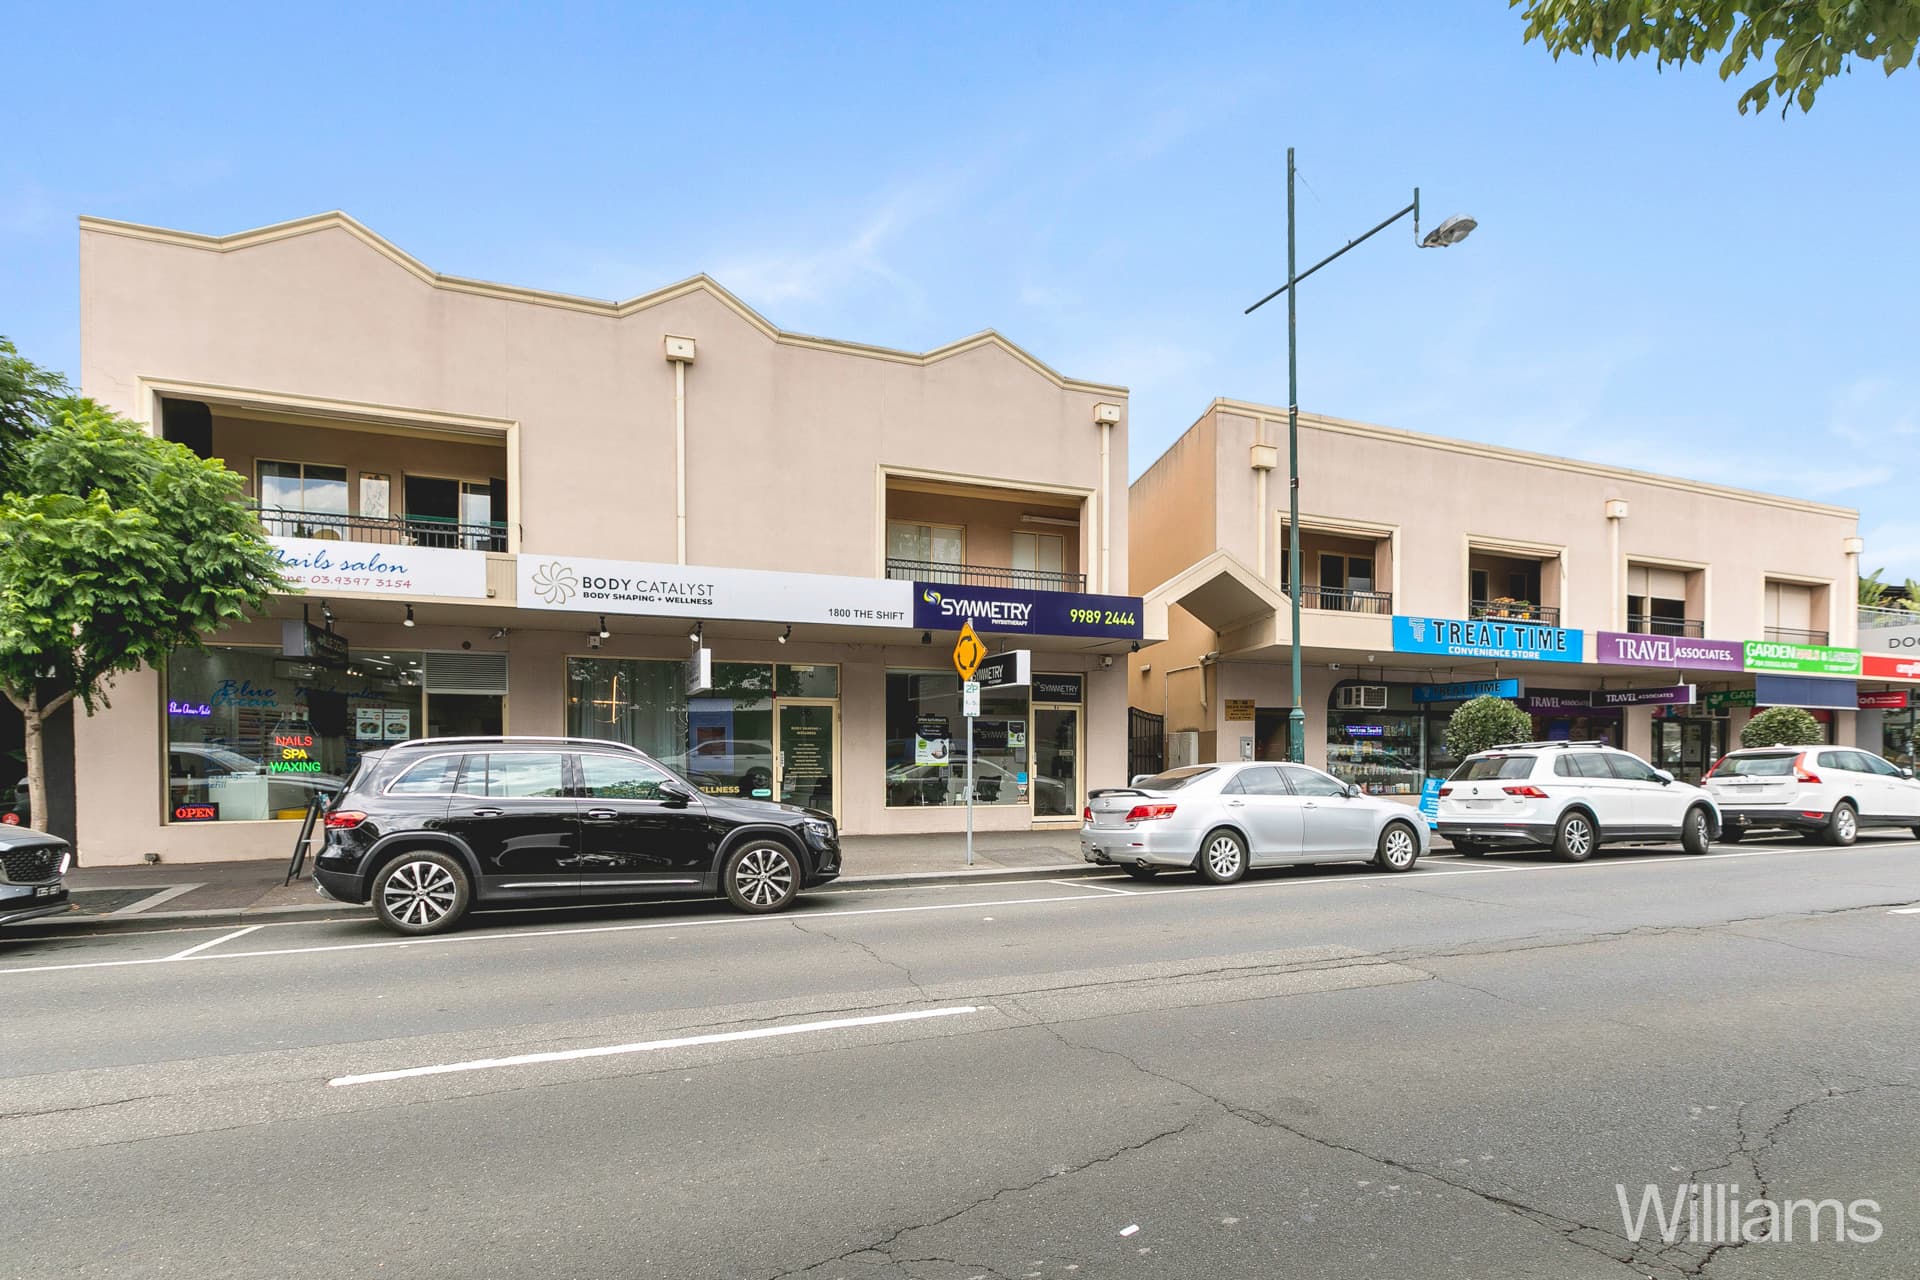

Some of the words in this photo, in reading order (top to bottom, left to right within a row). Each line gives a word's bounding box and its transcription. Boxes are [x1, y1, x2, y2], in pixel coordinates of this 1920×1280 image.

[340, 553, 408, 574] salon
[311, 575, 370, 586] 03.9397
[376, 578, 412, 589] 3154
[582, 576, 632, 591] BODY
[636, 580, 715, 597] CATALYST
[583, 591, 611, 600] BODY
[612, 593, 655, 603] SHAPING
[665, 596, 713, 606] WELLNESS
[828, 608, 851, 618] 1800
[854, 609, 874, 619] THE
[876, 611, 905, 621] SHIFT
[941, 598, 1033, 620] SYMMETRY
[1070, 608, 1102, 624] 9989
[1104, 611, 1136, 627] 2444
[1432, 620, 1508, 649] TREAT
[1513, 627, 1568, 652] TIME
[1888, 636, 1920, 649] DO
[1448, 646, 1511, 658] CONVENIENCE
[1512, 650, 1541, 660] STORE
[1615, 638, 1674, 662] TRAVEL
[1746, 642, 1796, 659] GARDEN
[217, 679, 276, 697] Blue
[1474, 682, 1501, 694] TIME
[1530, 696, 1560, 708] TRAVEL
[1606, 693, 1638, 703] TRAVEL
[1730, 691, 1754, 700] GAR
[275, 735, 313, 747] NAILS
[282, 748, 308, 760] SPA
[269, 761, 321, 773] WAXING
[699, 785, 740, 794] ELLNESS
[175, 807, 216, 819] OPEN
